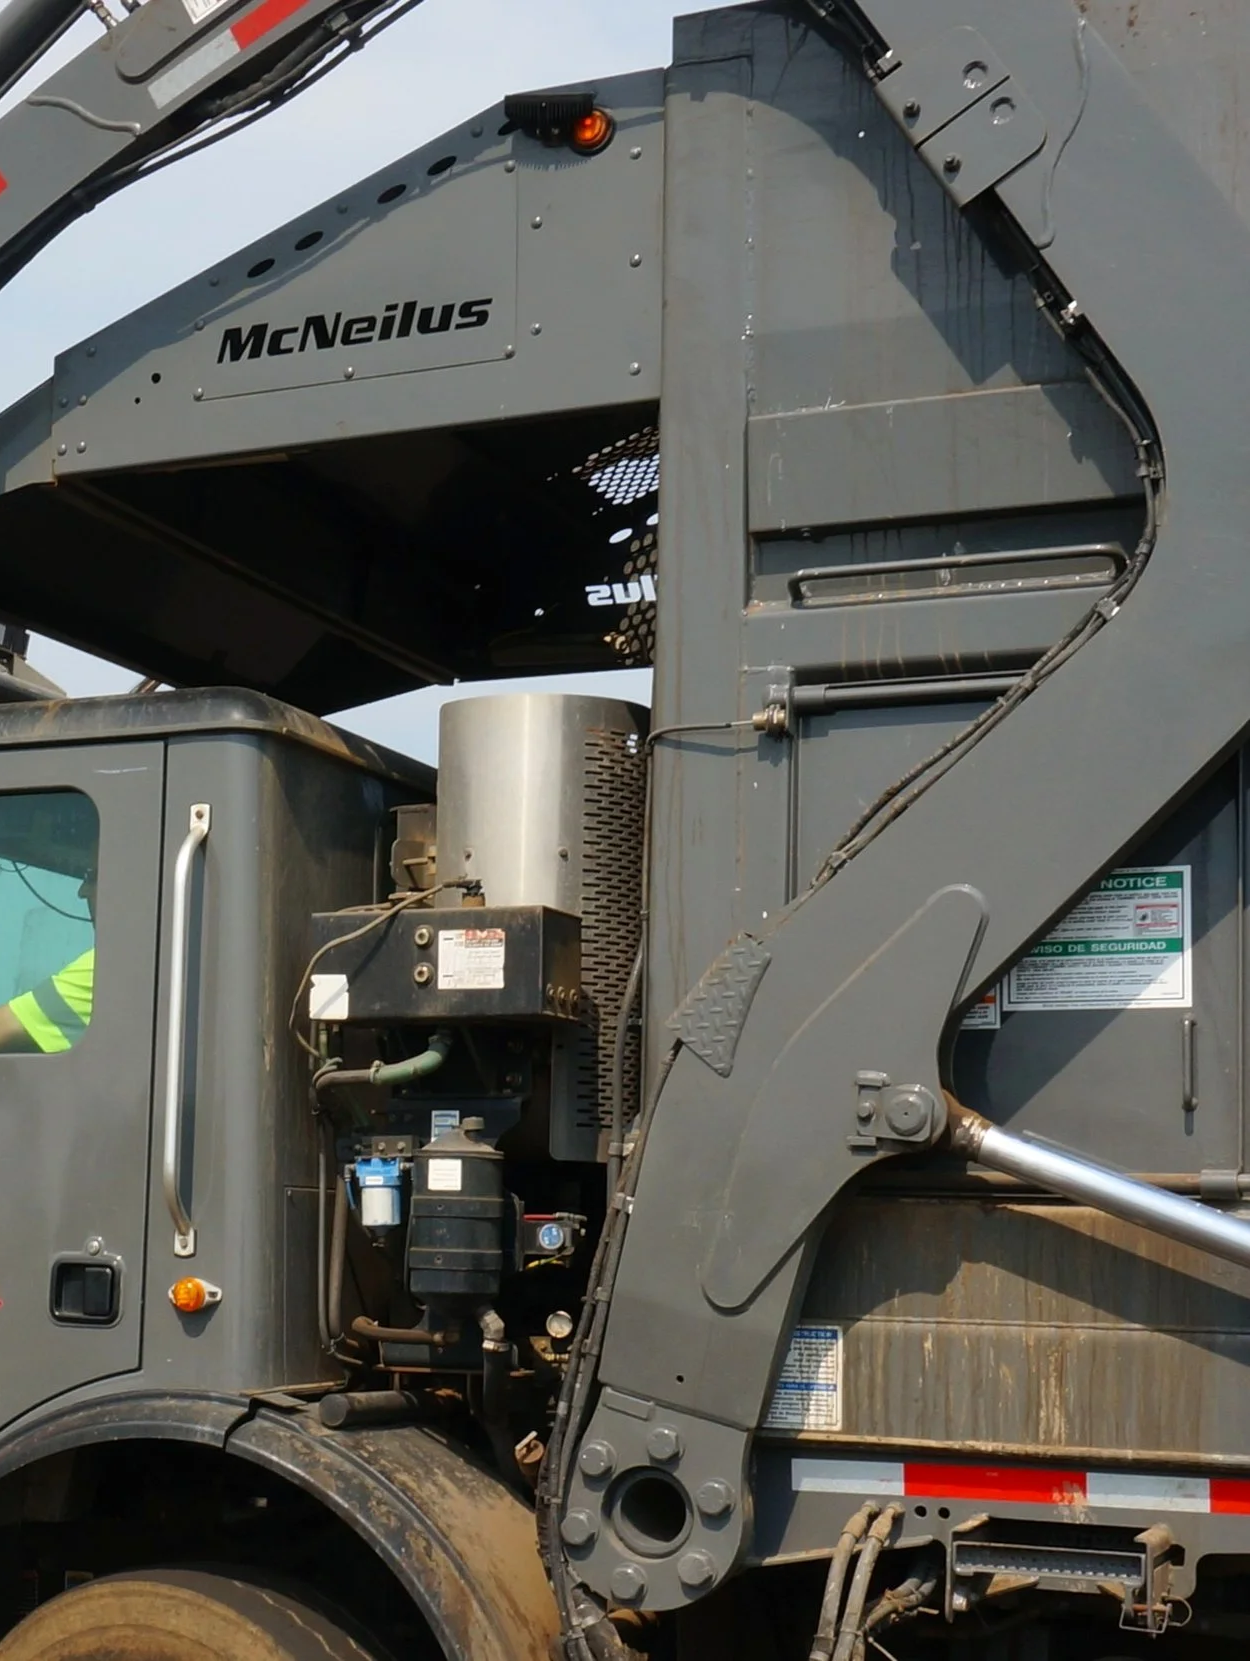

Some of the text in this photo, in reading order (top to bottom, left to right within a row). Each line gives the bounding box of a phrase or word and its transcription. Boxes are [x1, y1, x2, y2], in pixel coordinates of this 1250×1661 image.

[216, 298, 494, 364] McNeilus
[1100, 876, 1167, 889] NOTICE
[1068, 943, 1086, 953] DE
[1091, 941, 1167, 952] SEGURIDAD
